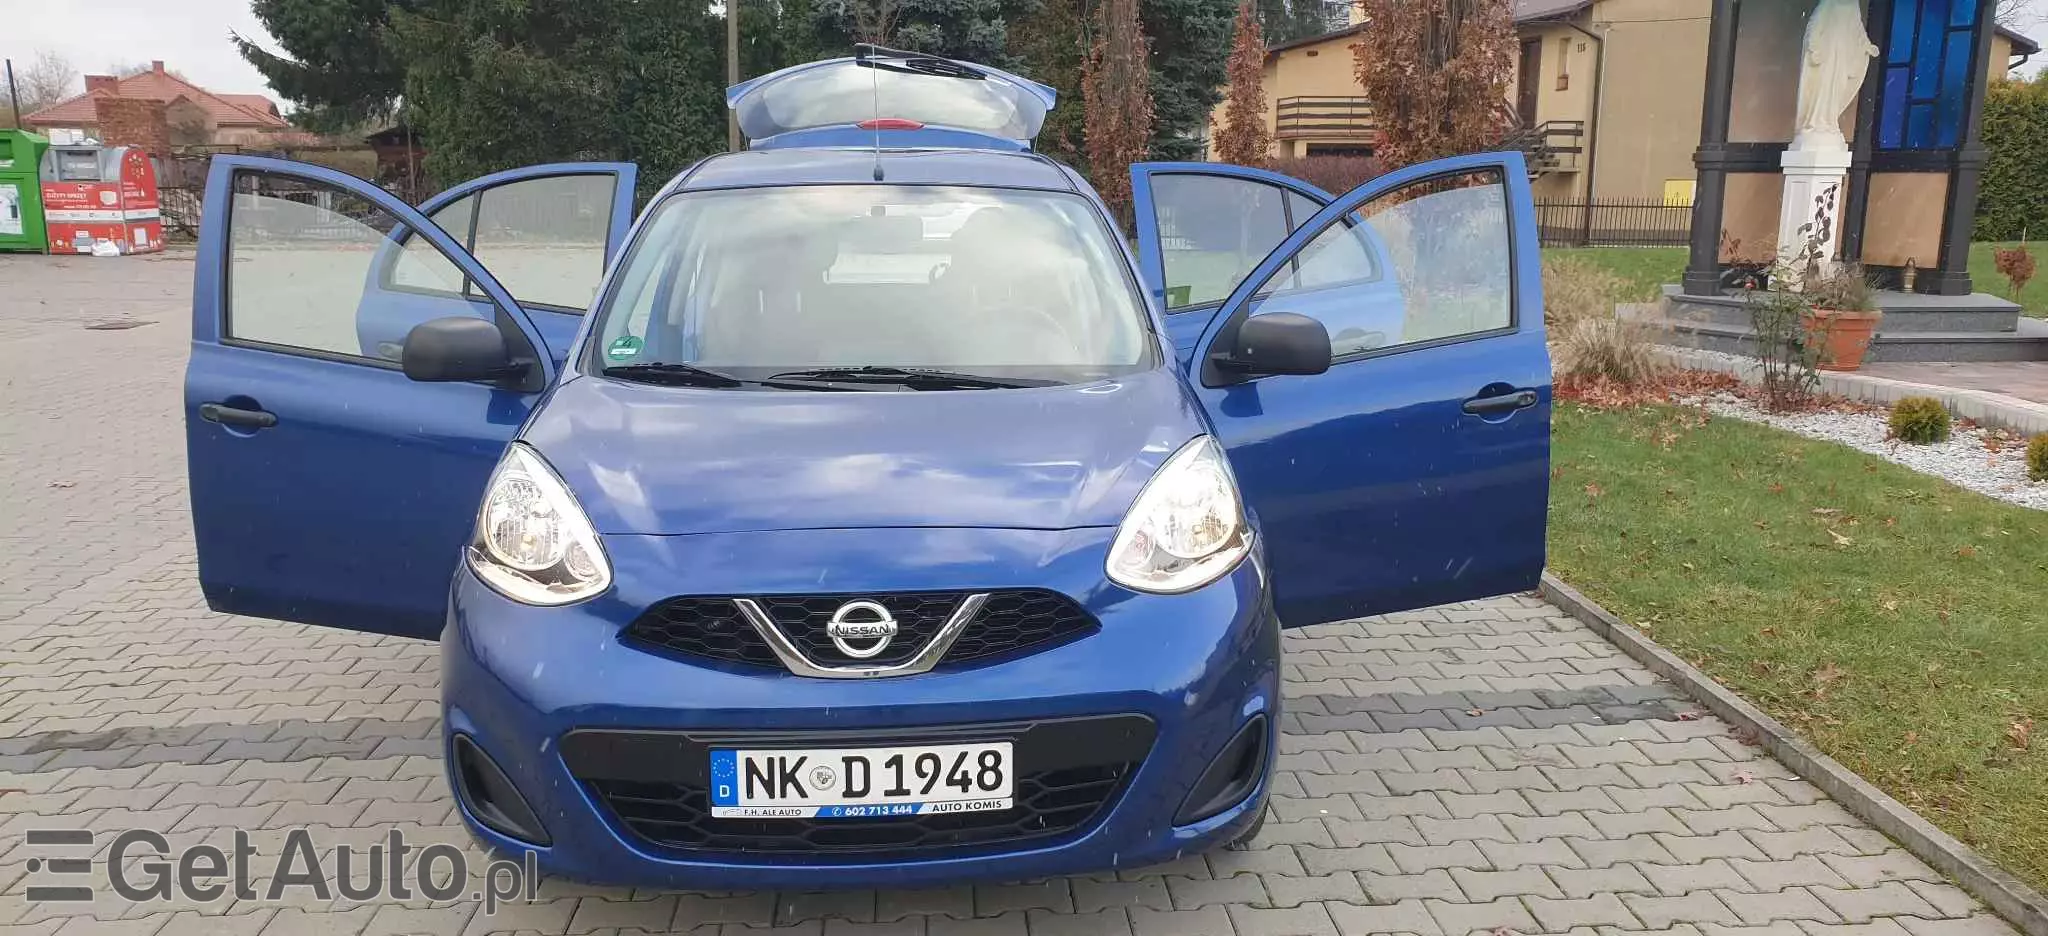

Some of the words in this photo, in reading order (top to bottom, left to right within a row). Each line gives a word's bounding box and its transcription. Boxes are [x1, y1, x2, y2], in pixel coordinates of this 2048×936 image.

[835, 623, 889, 635] NISSAN
[745, 755, 808, 799] NK
[842, 755, 871, 798] D
[883, 750, 1002, 797] 1948
[719, 785, 729, 797] D
[762, 808, 777, 816] ALE
[778, 808, 802, 816] AUTO
[845, 807, 867, 816] 602
[869, 806, 889, 815] 713
[891, 805, 912, 814] 444
[932, 802, 962, 812] AUTO
[965, 800, 1002, 811] KOMIS
